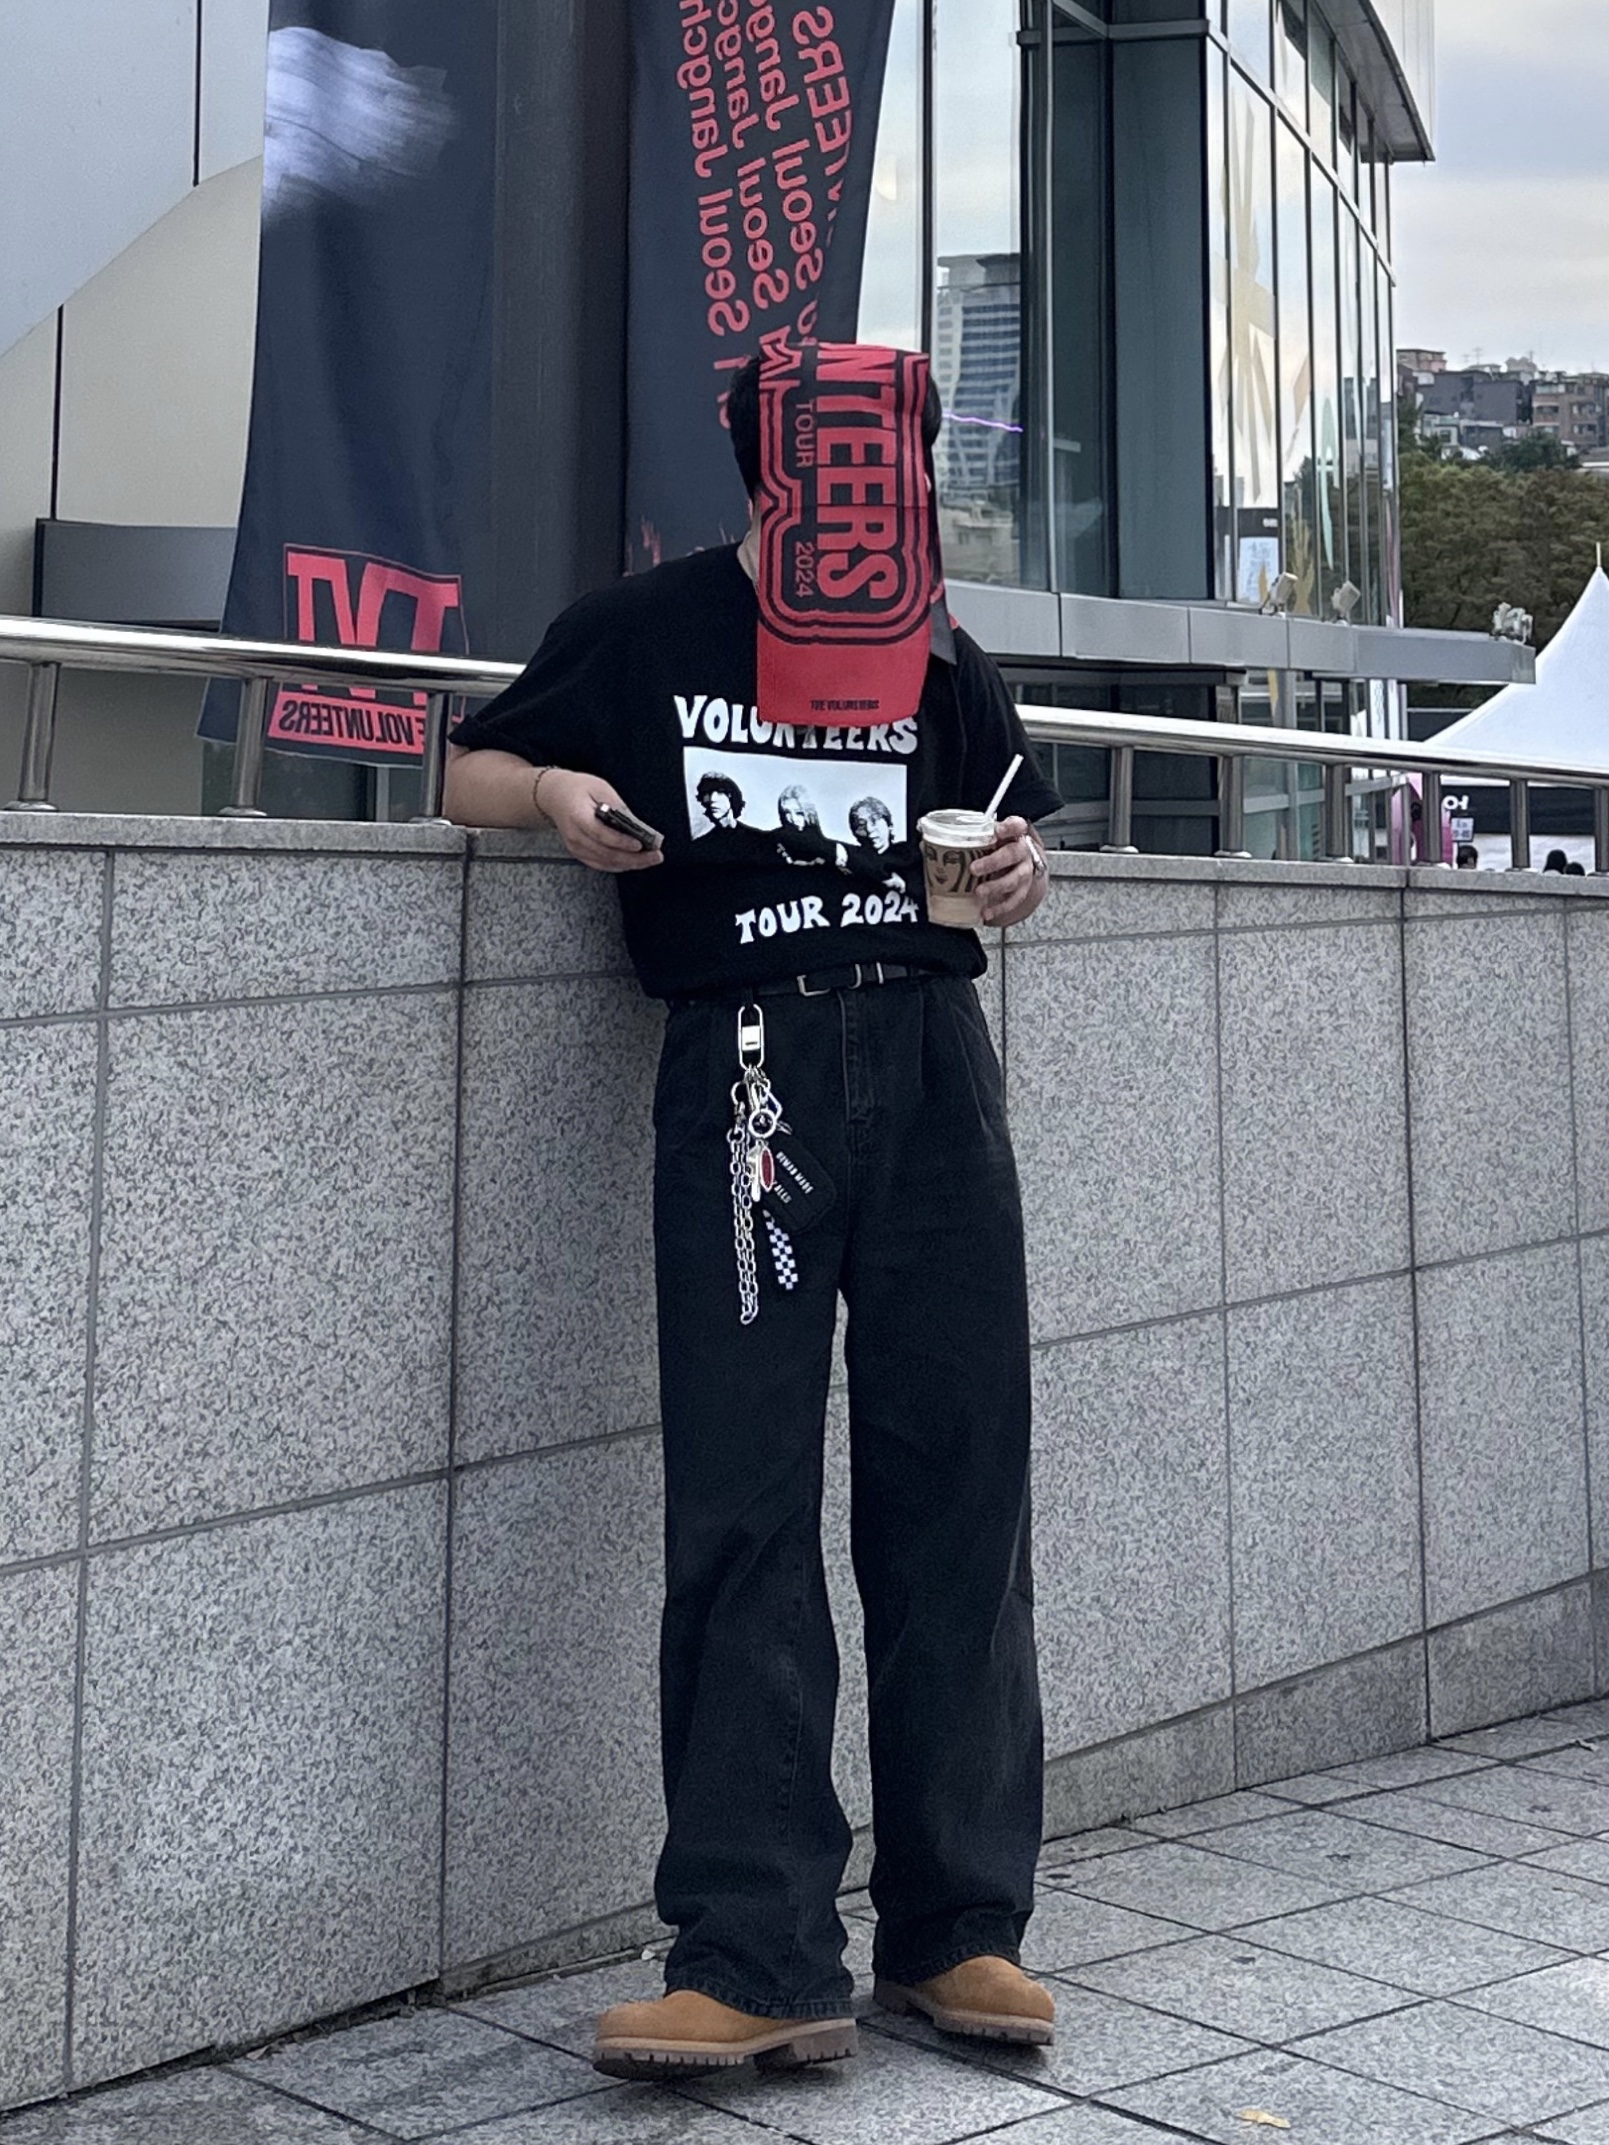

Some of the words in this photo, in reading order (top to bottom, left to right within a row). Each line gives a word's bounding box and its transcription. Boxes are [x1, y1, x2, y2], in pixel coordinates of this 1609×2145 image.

[794, 399, 814, 468] TOUR
[816, 344, 899, 599] NTEERS
[794, 541, 814, 598] 2024
[735, 896, 830, 944] TOUR
[841, 891, 919, 926] 2024
